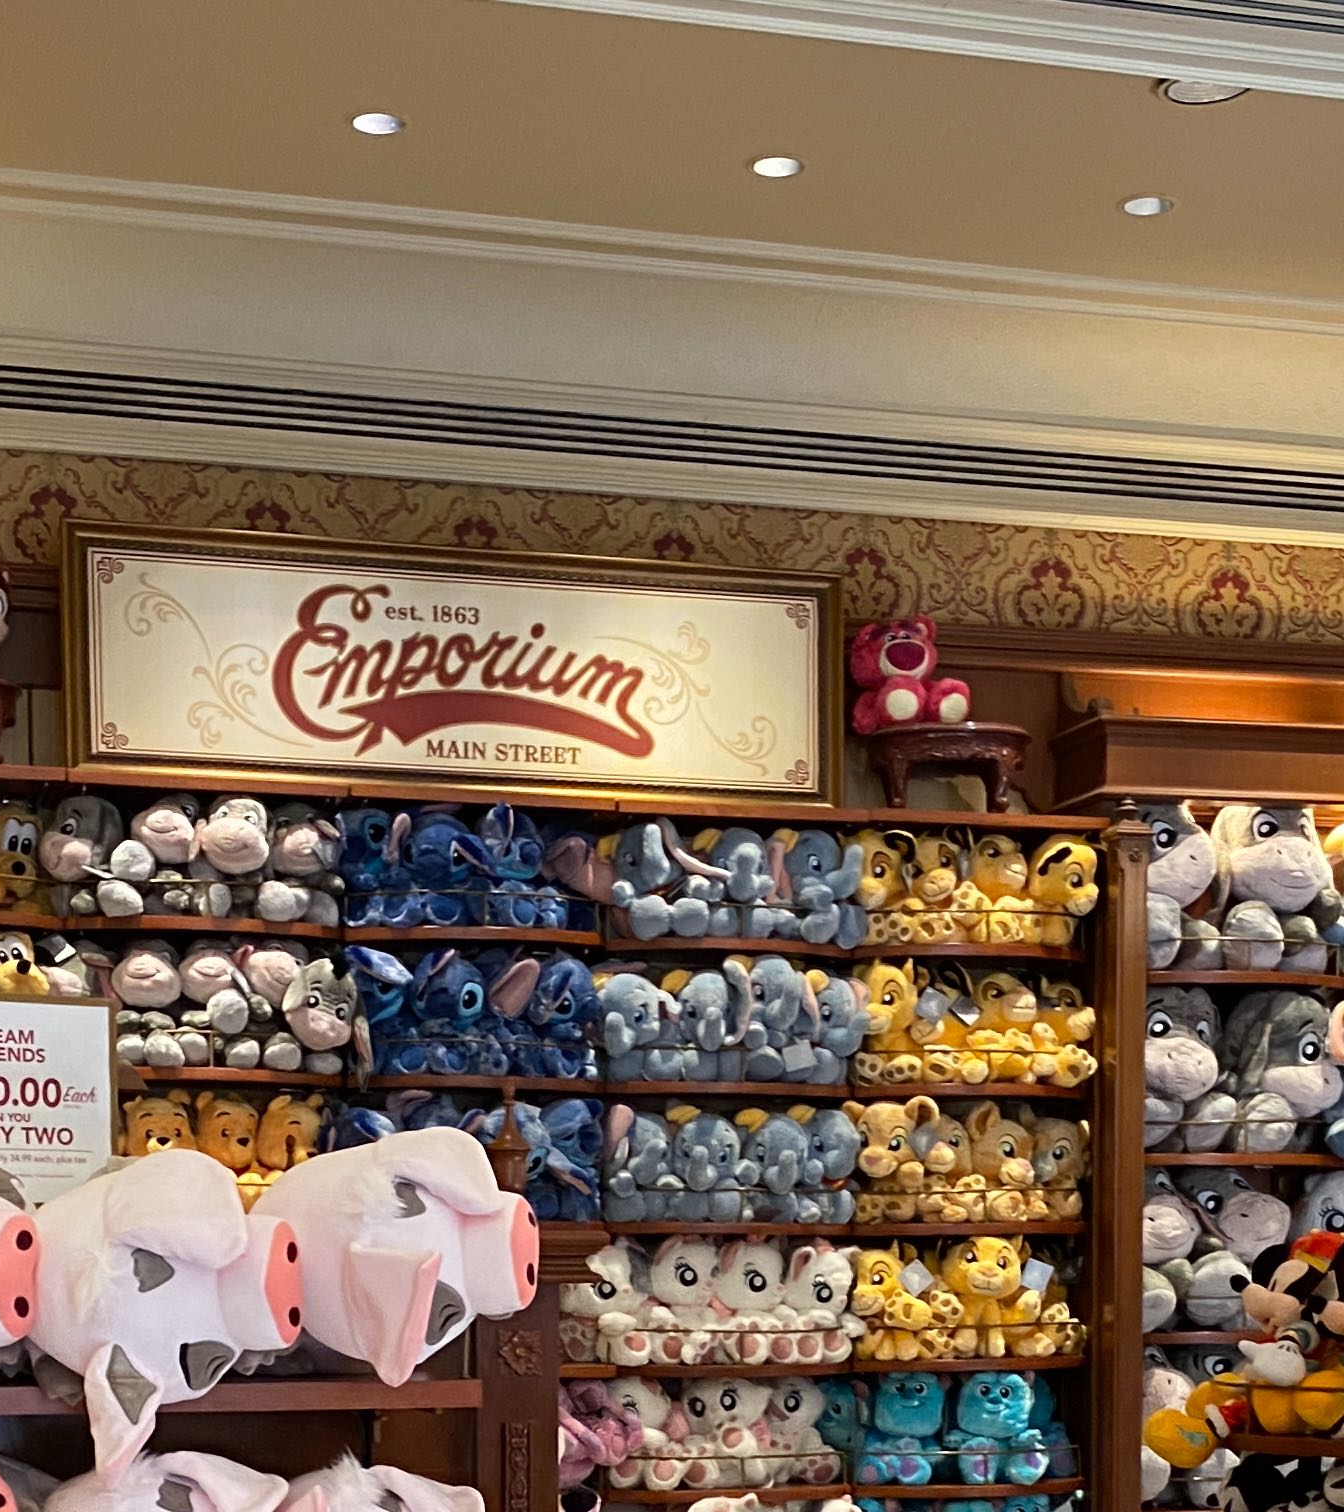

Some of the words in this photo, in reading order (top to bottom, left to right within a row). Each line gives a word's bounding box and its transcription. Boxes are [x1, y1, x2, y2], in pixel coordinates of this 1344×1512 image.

[384, 605, 423, 621] est.
[432, 604, 480, 625] 1863
[272, 583, 654, 757] Emporium
[426, 739, 487, 760] MAIN
[495, 743, 581, 765] STREET
[63, 1086, 97, 1103] Each
[8, 1112, 31, 1123] YOU
[18, 1127, 74, 1146] TWO
